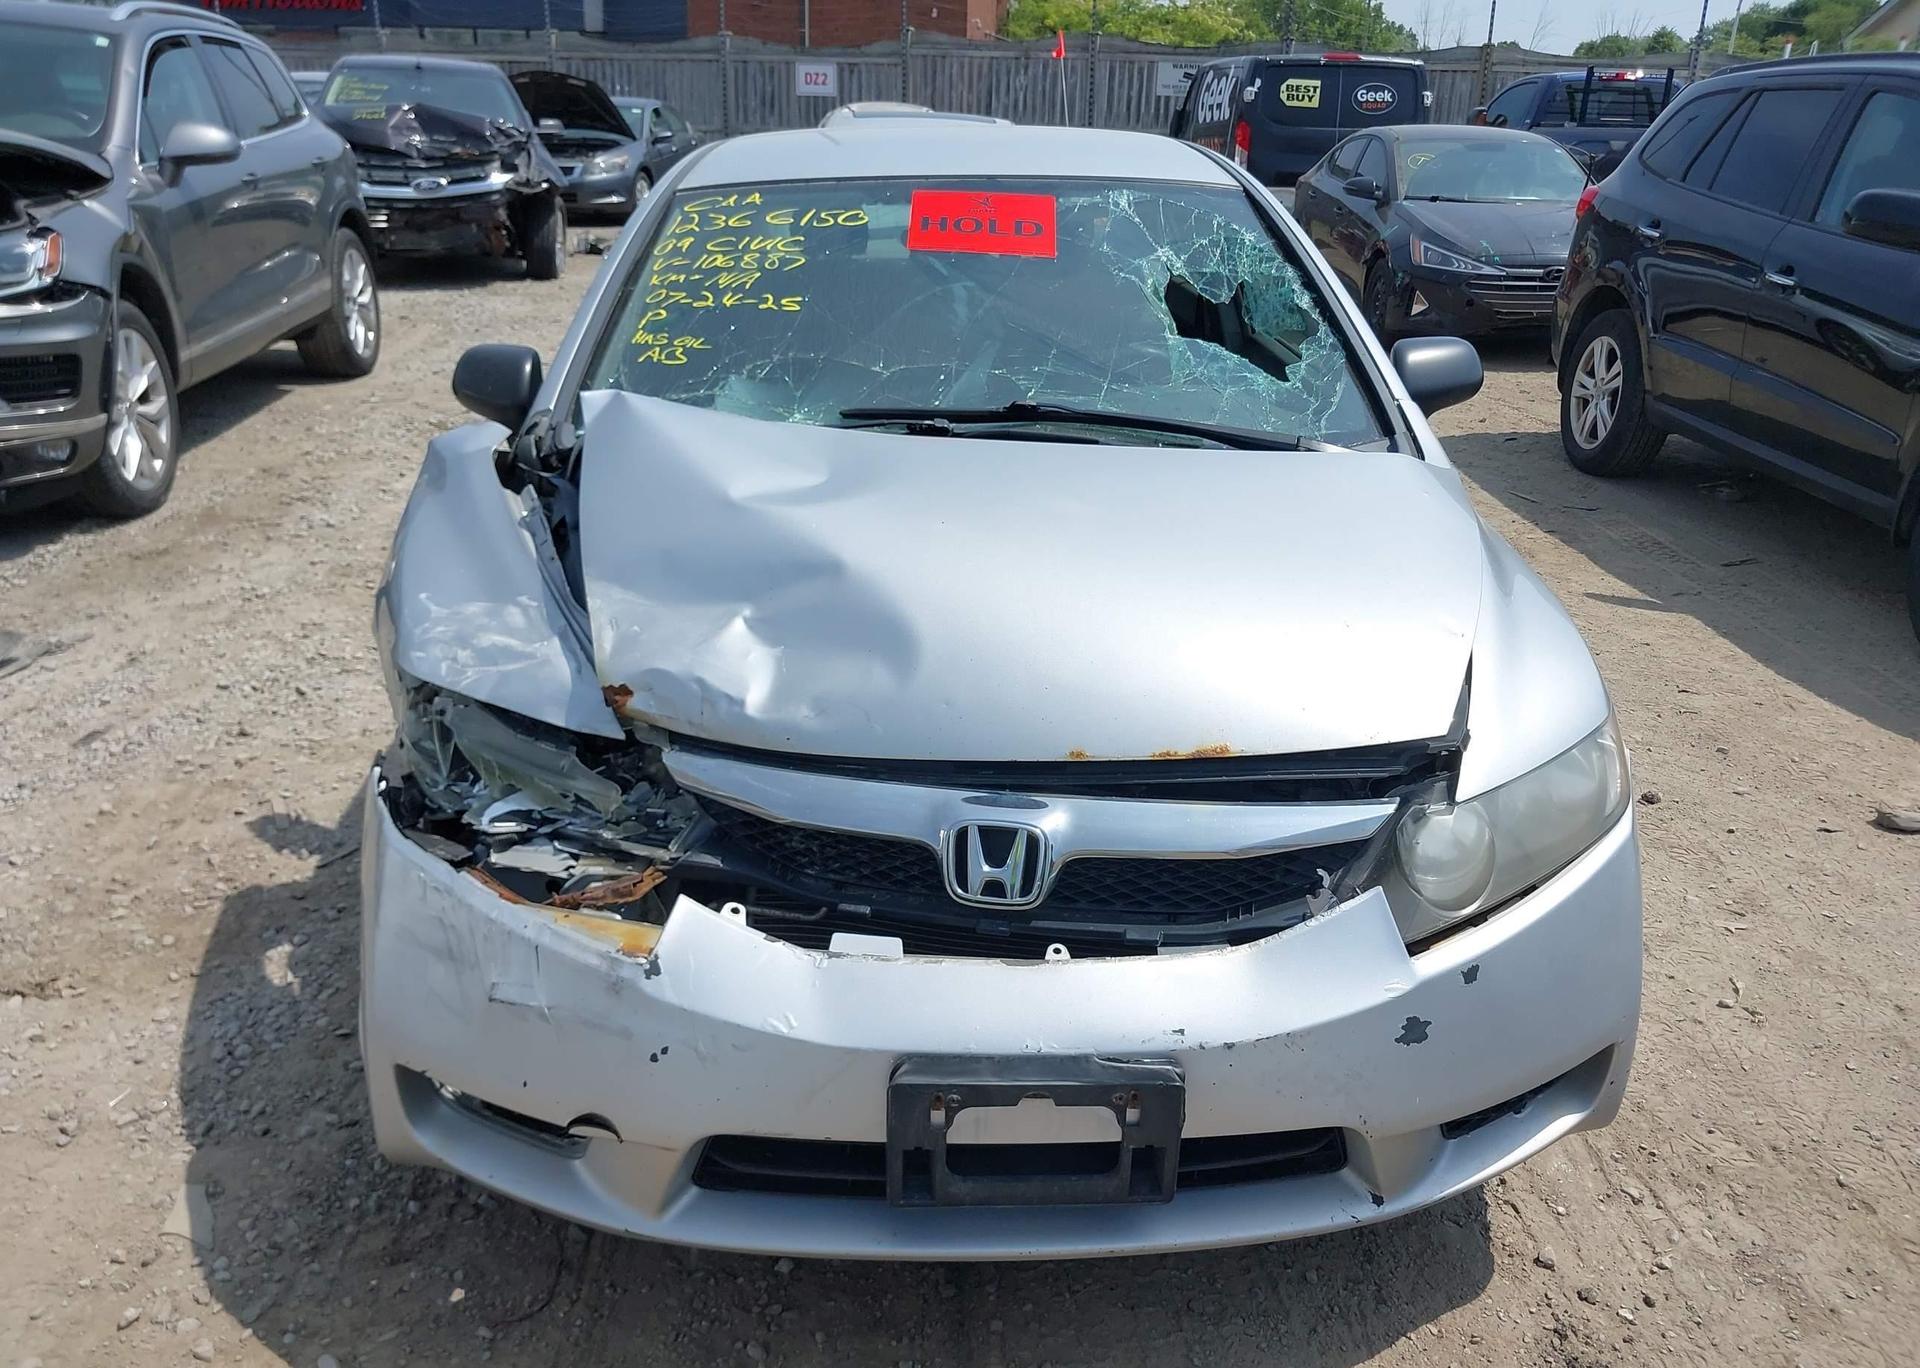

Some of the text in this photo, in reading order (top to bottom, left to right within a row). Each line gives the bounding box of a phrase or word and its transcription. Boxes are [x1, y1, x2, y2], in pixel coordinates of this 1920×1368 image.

[1197, 64, 1237, 124] Geek
[1285, 84, 1319, 94] BEST
[1357, 89, 1393, 102] Geek
[1286, 93, 1315, 103] BUY
[920, 215, 1044, 237] HOLD
